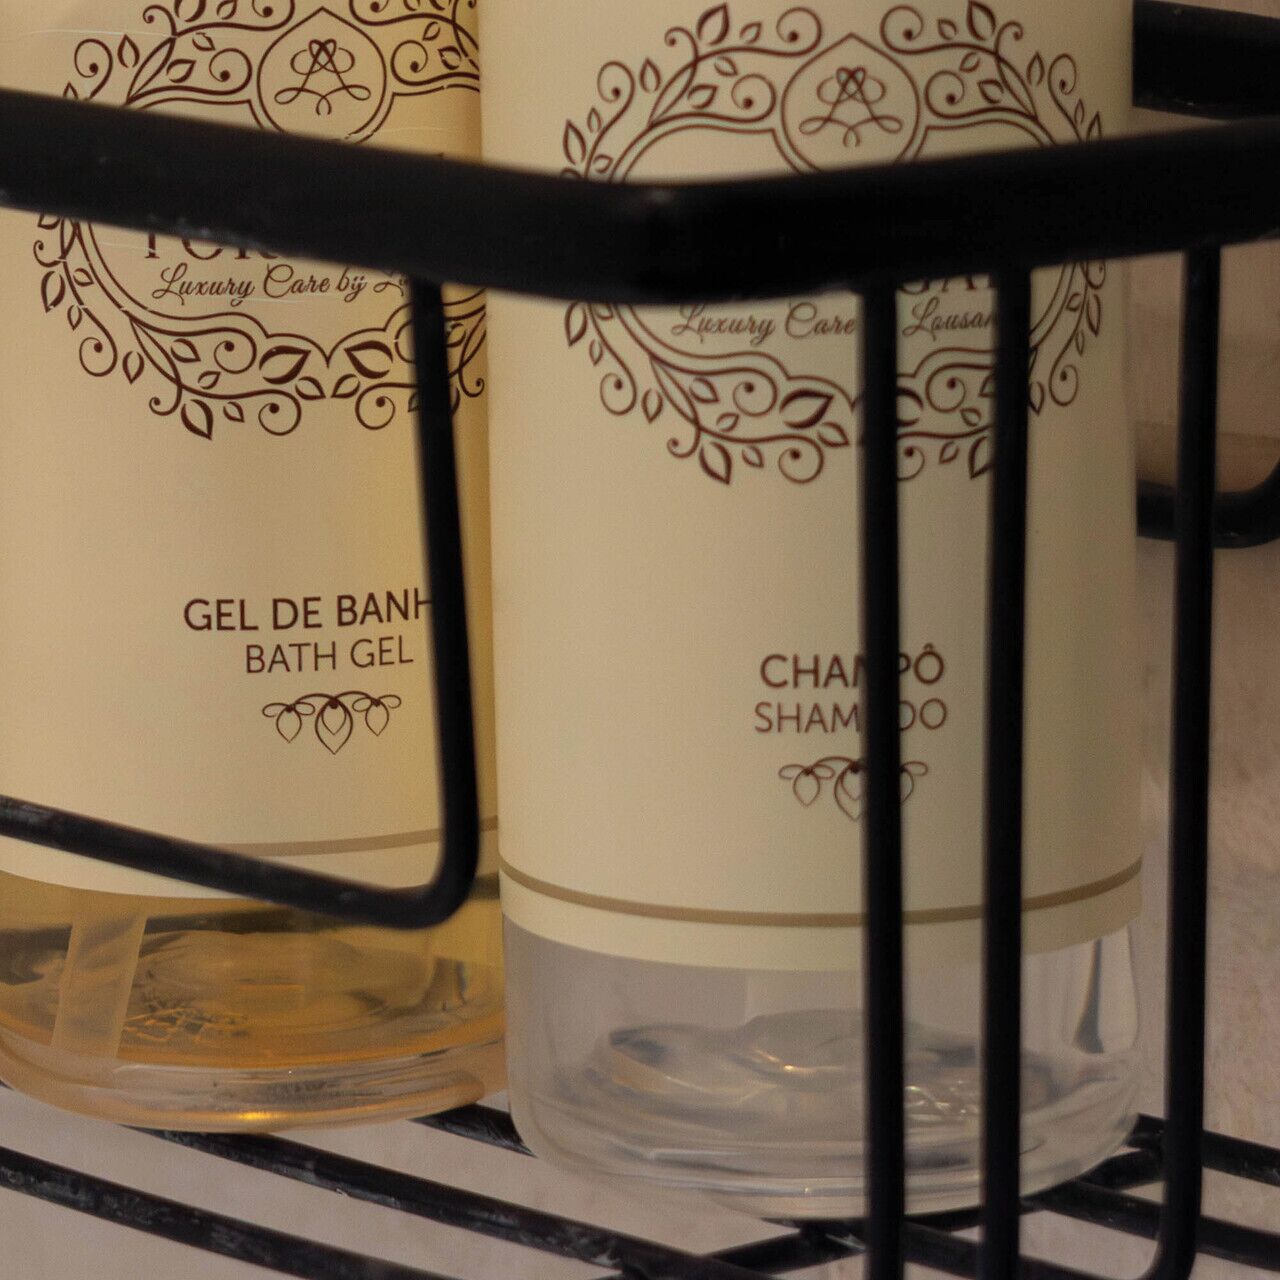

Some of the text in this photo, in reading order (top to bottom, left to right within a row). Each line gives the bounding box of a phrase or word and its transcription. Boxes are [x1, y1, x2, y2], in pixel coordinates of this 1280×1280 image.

[152, 262, 256, 308] Luxury
[263, 263, 331, 298] Care
[671, 301, 777, 345] Luxury
[785, 297, 857, 339] Care
[183, 587, 432, 632] GEL DE BANH
[245, 634, 415, 674] BATH GEL
[754, 697, 948, 734] SHAMOO
